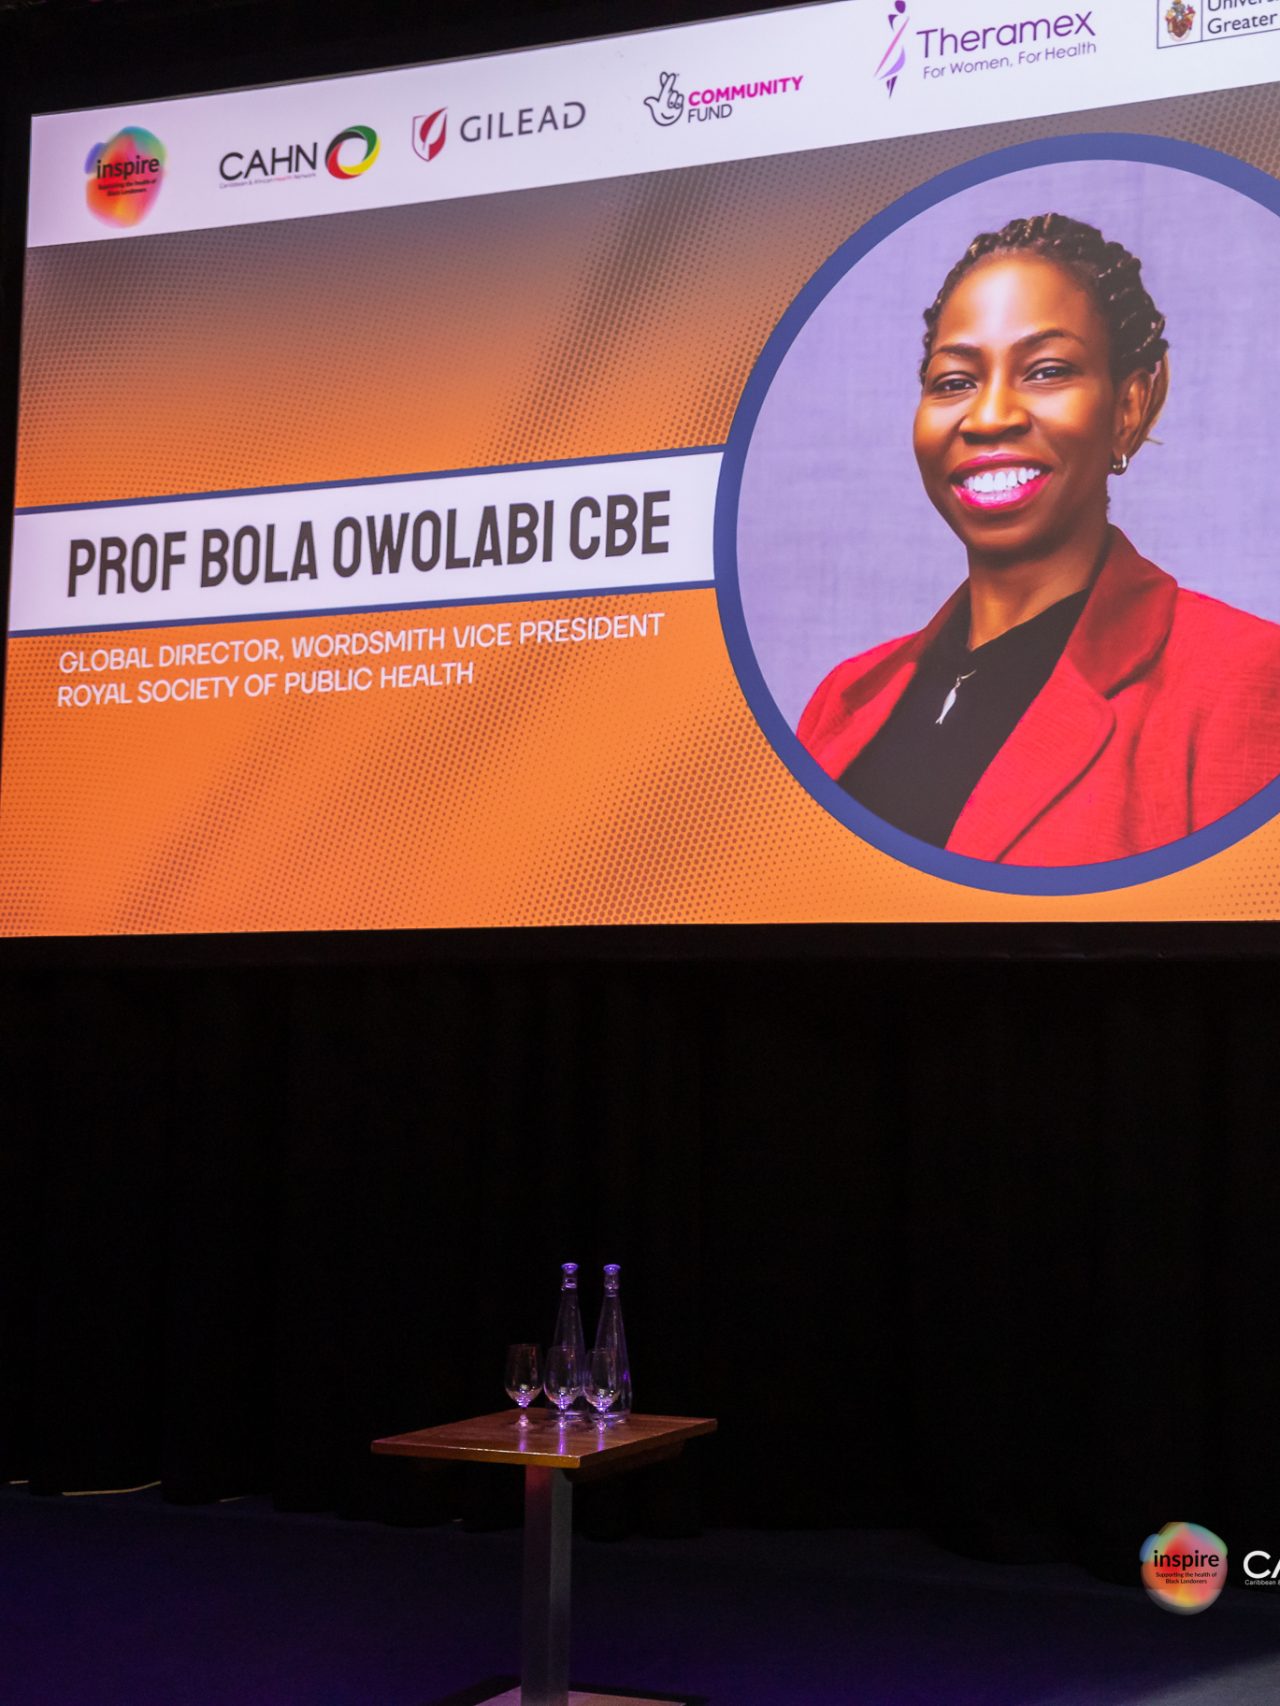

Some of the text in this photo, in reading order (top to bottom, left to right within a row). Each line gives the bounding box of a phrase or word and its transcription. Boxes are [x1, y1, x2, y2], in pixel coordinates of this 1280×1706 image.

[916, 11, 1096, 58] Theramex
[1207, 13, 1278, 35] Greater
[923, 41, 1097, 80] For Women, For Health
[688, 75, 804, 107] COMMUNITY
[459, 101, 586, 143] GILEAD
[687, 103, 733, 123] FUND
[96, 154, 160, 180] inspire
[219, 142, 318, 181] CAHN
[67, 490, 671, 598] PROF BOLA OWOLABI CBE
[59, 613, 666, 674] GLOBAL DIRECTOR, WORDSMITH VICE PRESIDENT
[57, 661, 474, 708] ROYAL SOCIETY OF PUBLIC HEALTH
